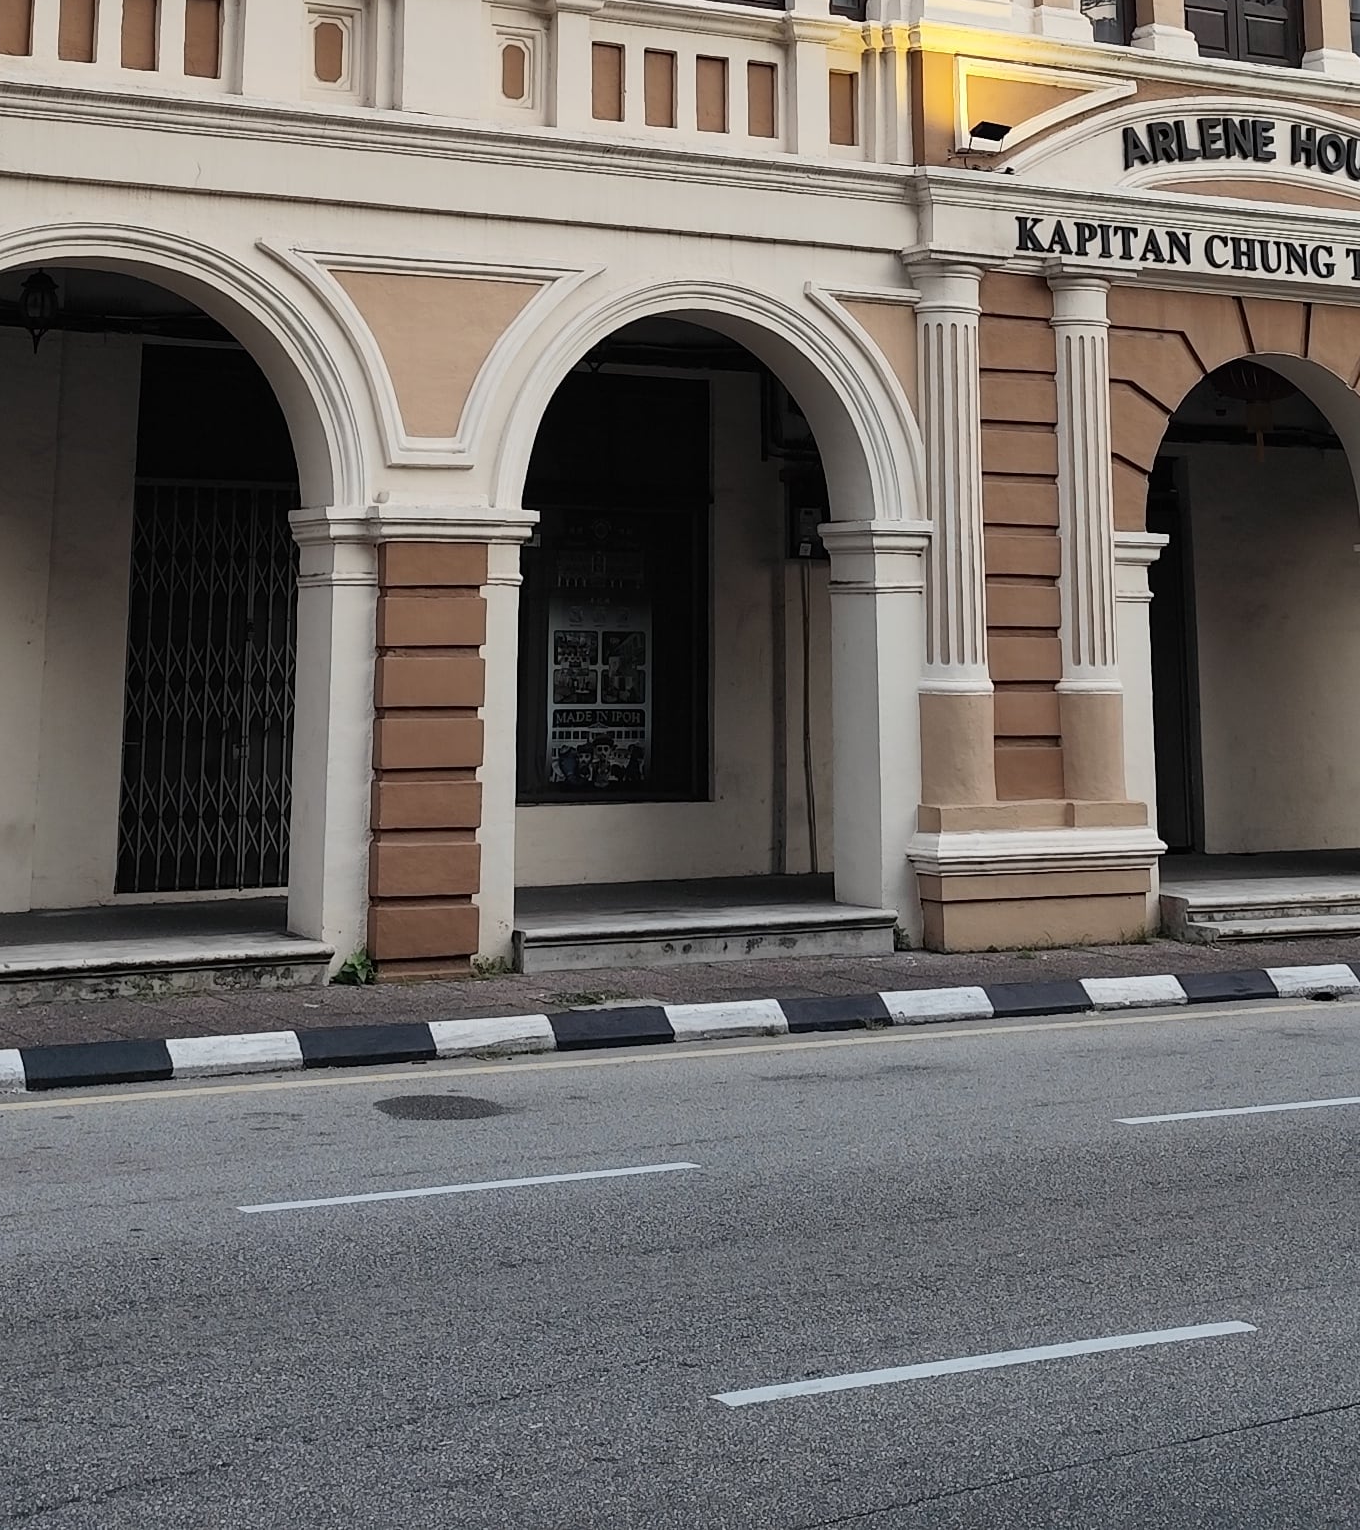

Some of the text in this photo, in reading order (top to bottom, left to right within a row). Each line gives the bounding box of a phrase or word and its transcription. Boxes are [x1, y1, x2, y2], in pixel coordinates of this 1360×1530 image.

[1122, 117, 1277, 171] ARLENE
[1014, 215, 1193, 266] KAPITAN
[1204, 234, 1337, 279] CHUNG
[555, 710, 641, 725] MADE IN IPOH
